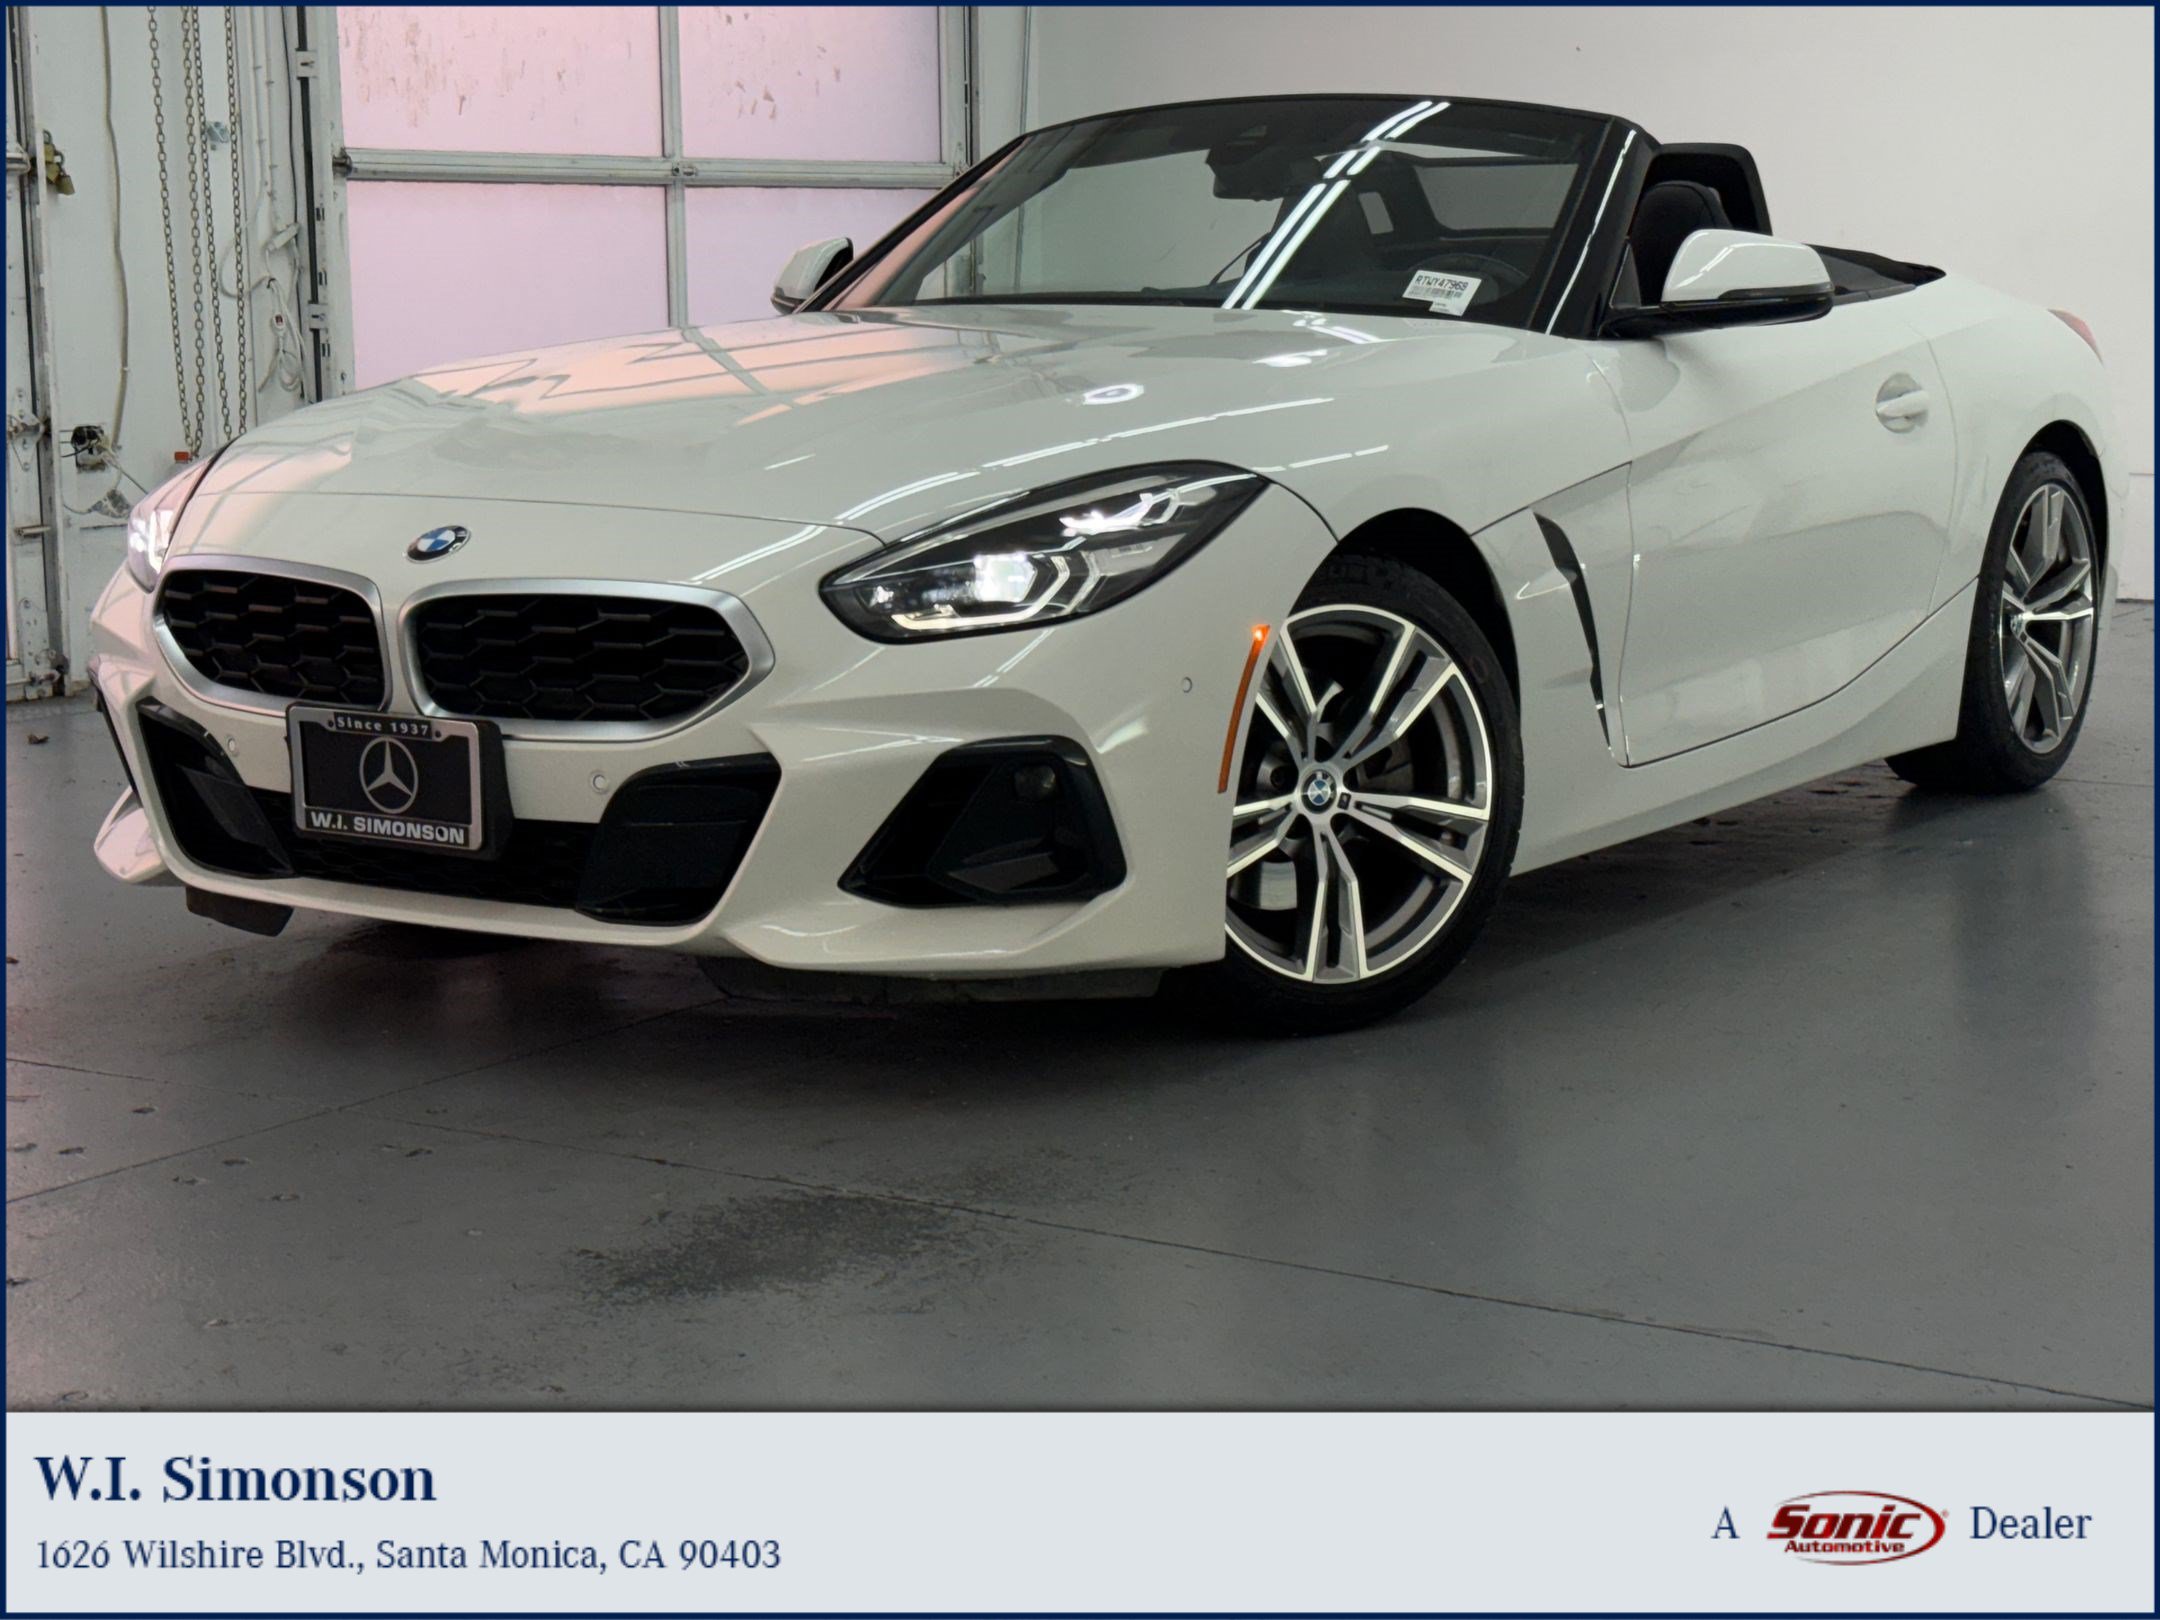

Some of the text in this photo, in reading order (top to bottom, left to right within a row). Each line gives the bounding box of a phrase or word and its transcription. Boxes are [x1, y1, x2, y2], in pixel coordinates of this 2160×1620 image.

[336, 716, 428, 736] Since 1937
[310, 811, 465, 844] W.I. SIMONSON
